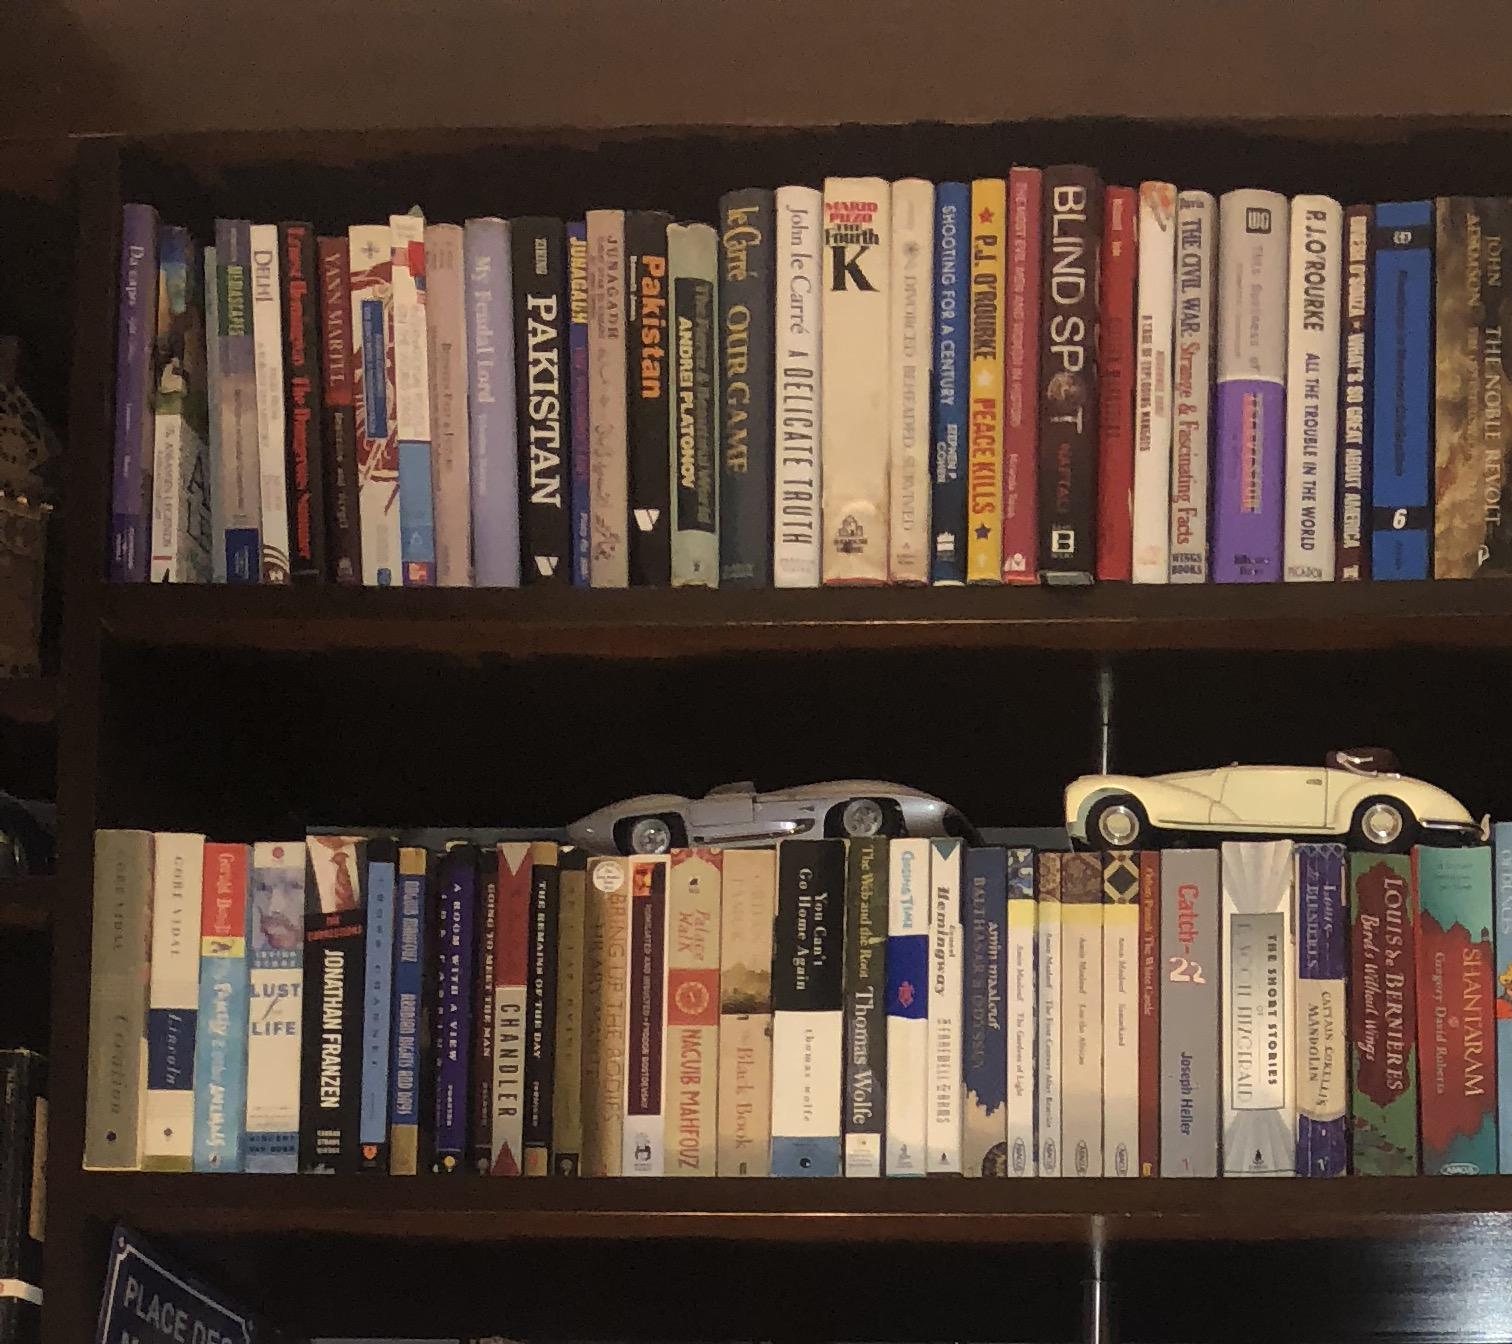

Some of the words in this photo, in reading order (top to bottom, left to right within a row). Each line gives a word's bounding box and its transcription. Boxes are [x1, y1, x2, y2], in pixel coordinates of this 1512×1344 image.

[831, 246, 880, 292] K
[1052, 186, 1086, 305] BLIND
[1303, 239, 1326, 332] O'ROURKE
[641, 255, 667, 399] Pakistan
[679, 317, 694, 388] ANDREI
[788, 350, 809, 359] A
[527, 294, 561, 507] PAKISTAN
[782, 368, 813, 470] DELICATE
[678, 392, 694, 489] PLATONOV
[782, 477, 812, 545] TRUTH
[799, 868, 811, 890] Go
[813, 892, 829, 921] You
[799, 894, 810, 944] Home
[811, 928, 827, 968] Can't
[250, 982, 300, 999] LUST
[321, 950, 343, 1027] JONATHAN
[793, 948, 807, 990] Again
[1169, 957, 1206, 985] 22
[252, 1022, 296, 1036] LIFE
[855, 986, 874, 1066] Thomas
[1461, 948, 1485, 1098] SHANTARAM
[321, 1031, 342, 1108] FRANZEN
[498, 1004, 520, 1117] CHANDLER
[1181, 1051, 1193, 1101] Joseph
[852, 1068, 874, 1126] Wolfe
[1180, 1105, 1192, 1136] Heller
[124, 1276, 188, 1344] PLACE
